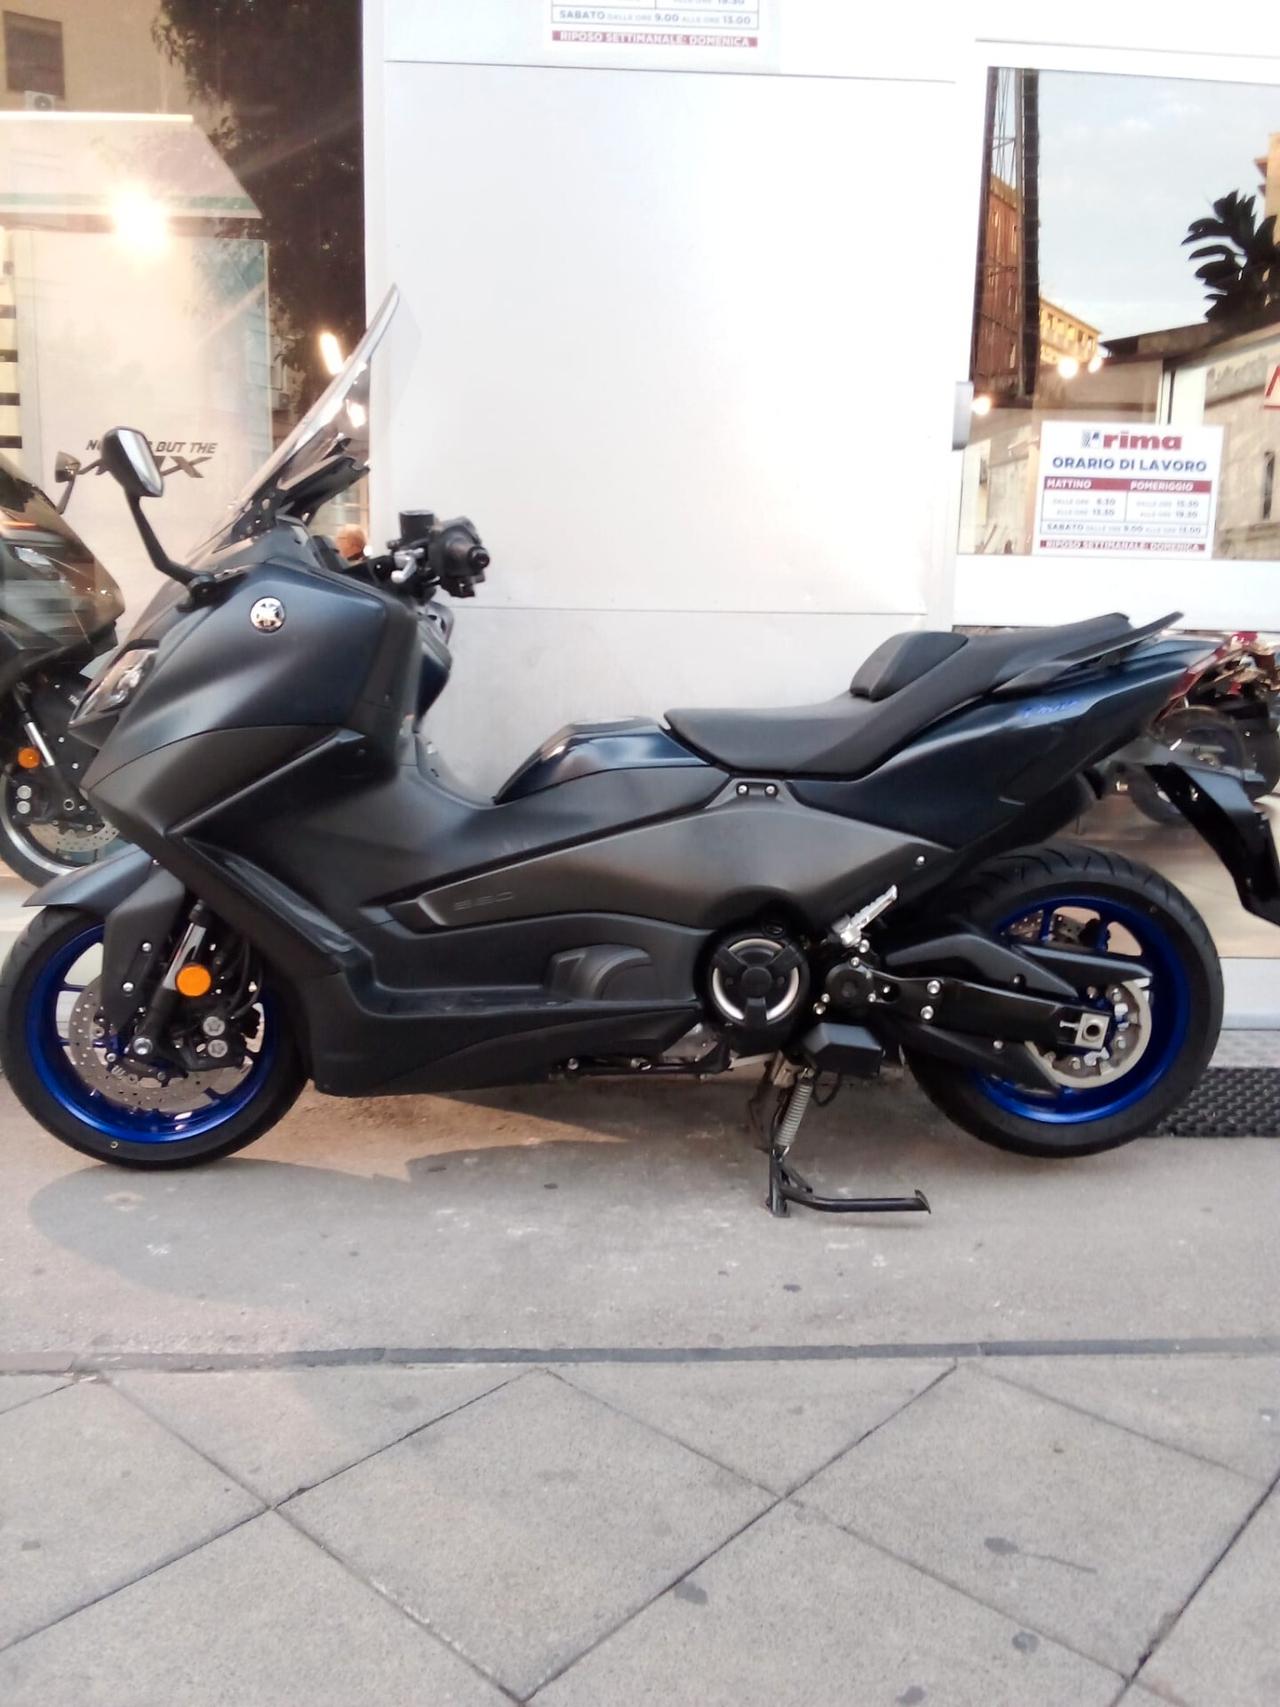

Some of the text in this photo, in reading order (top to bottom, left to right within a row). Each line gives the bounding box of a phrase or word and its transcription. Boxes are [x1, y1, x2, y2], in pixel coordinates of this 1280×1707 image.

[560, 10, 606, 20] SABATO
[560, 31, 603, 42] RIPOSO
[689, 35, 750, 47] DOMENICA
[156, 441, 186, 453] BUT
[190, 442, 218, 454] THE
[1052, 456, 1208, 473] ORARIO DI LAVORO
[1046, 478, 1092, 489] MATTINO
[1130, 480, 1194, 492] POMERIGGIO
[1047, 523, 1084, 531] SABATO
